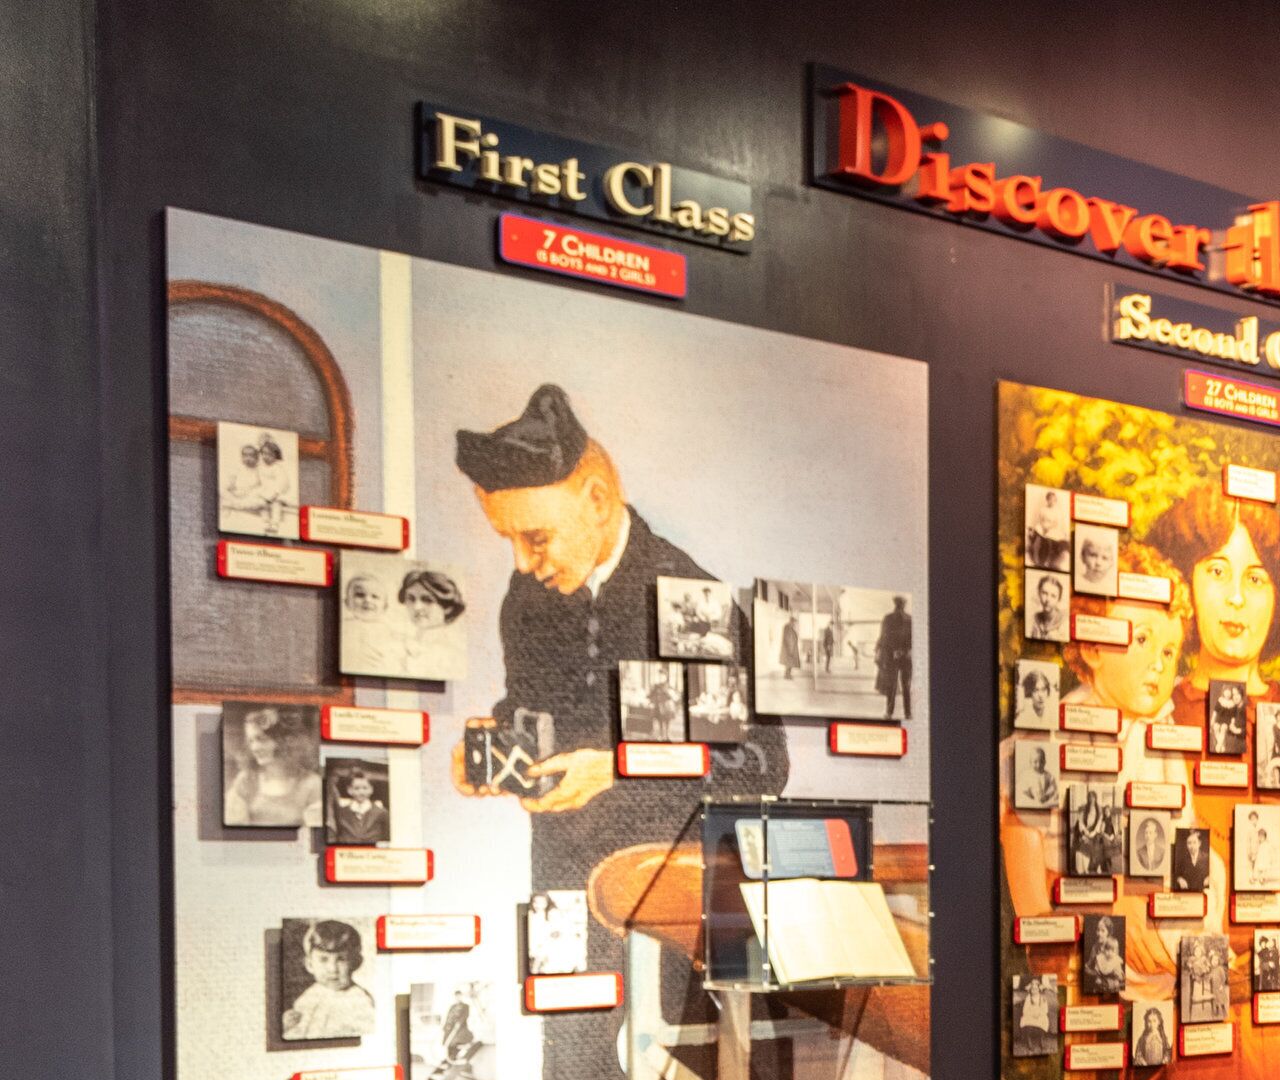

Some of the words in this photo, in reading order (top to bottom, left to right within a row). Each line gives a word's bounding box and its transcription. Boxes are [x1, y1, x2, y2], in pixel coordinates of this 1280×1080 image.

[435, 112, 587, 200] First
[606, 161, 755, 242] Class
[835, 82, 1211, 272] Discover
[543, 229, 557, 250] 7
[1115, 293, 1261, 365] Second
[1206, 379, 1222, 397] 27
